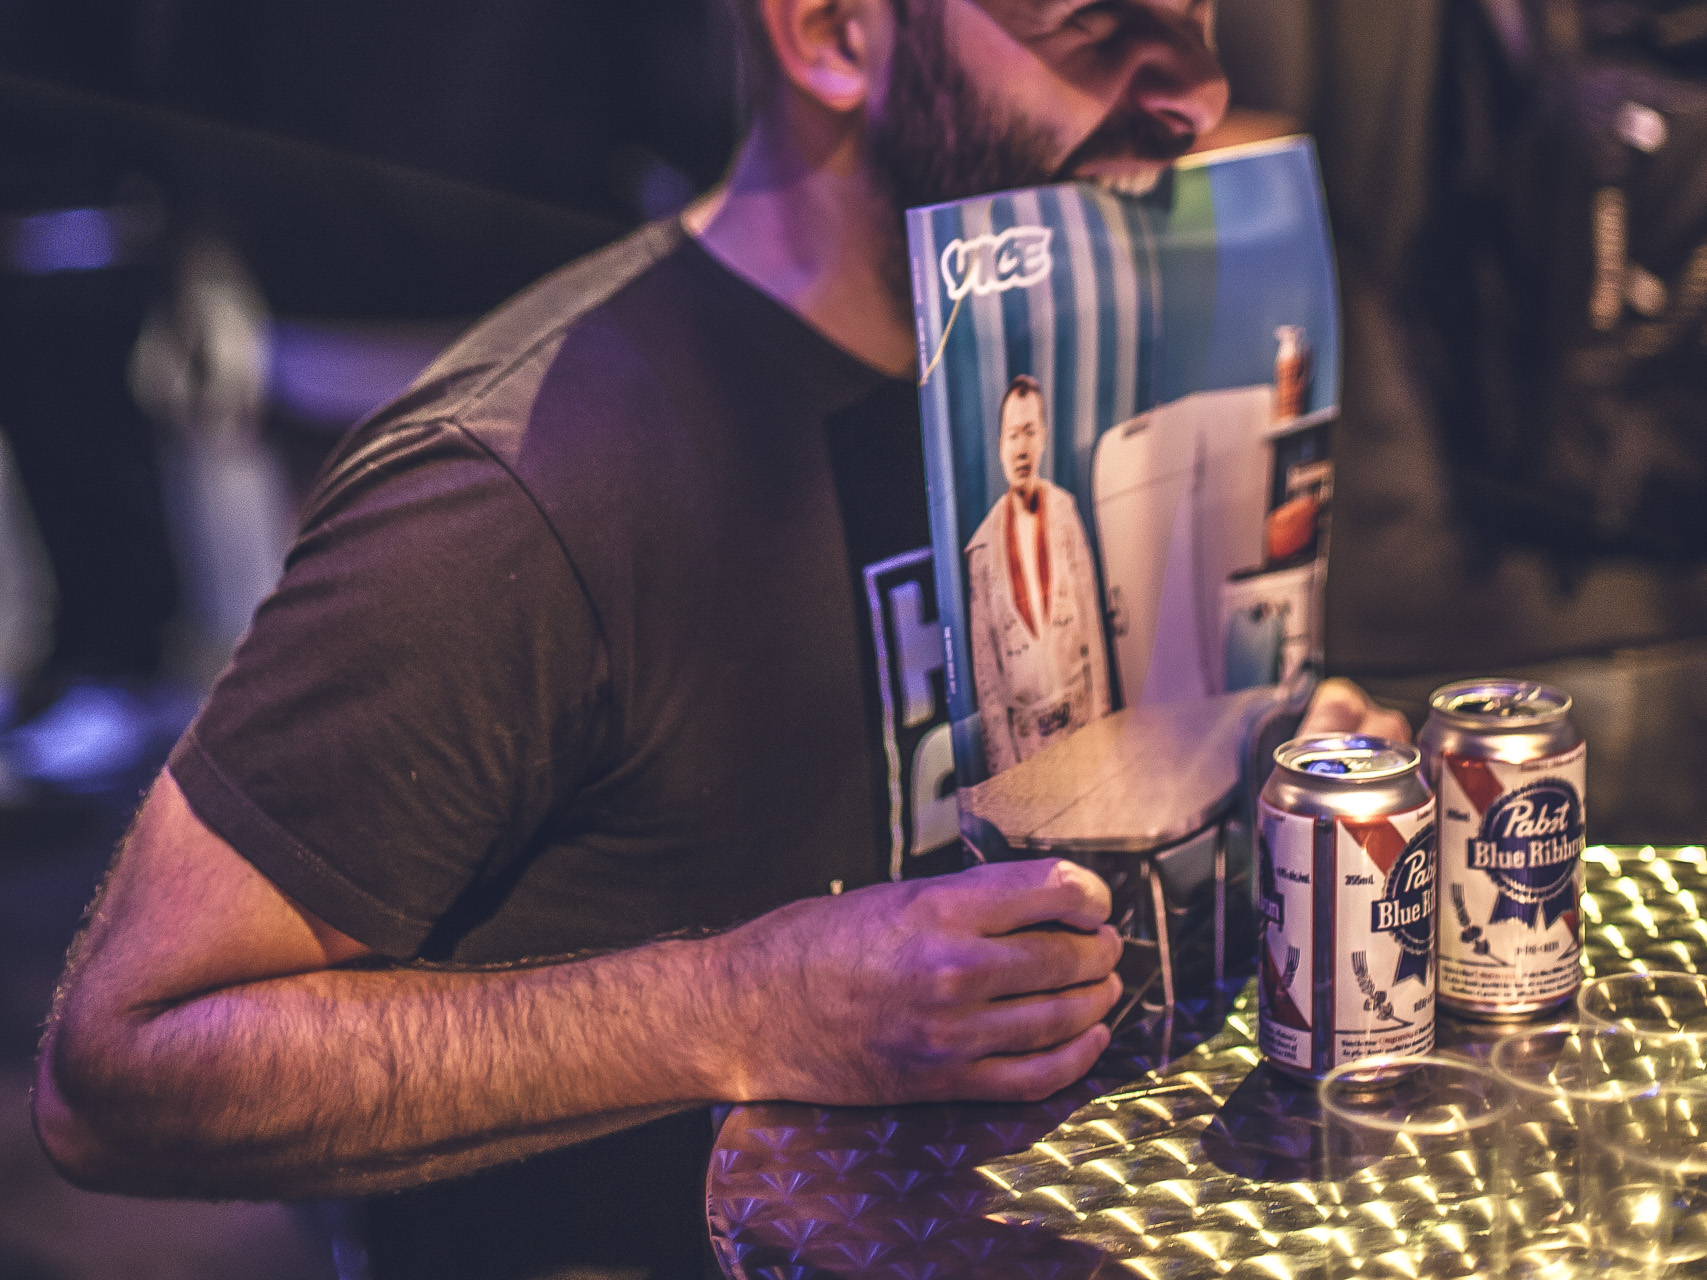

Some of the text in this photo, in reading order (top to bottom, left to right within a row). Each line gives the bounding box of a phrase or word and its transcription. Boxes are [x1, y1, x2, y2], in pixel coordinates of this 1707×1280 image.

[941, 225, 1053, 301] VICE
[1502, 799, 1570, 838] Pabst
[1474, 841, 1526, 869] Blue
[1377, 900, 1421, 930] Blue
